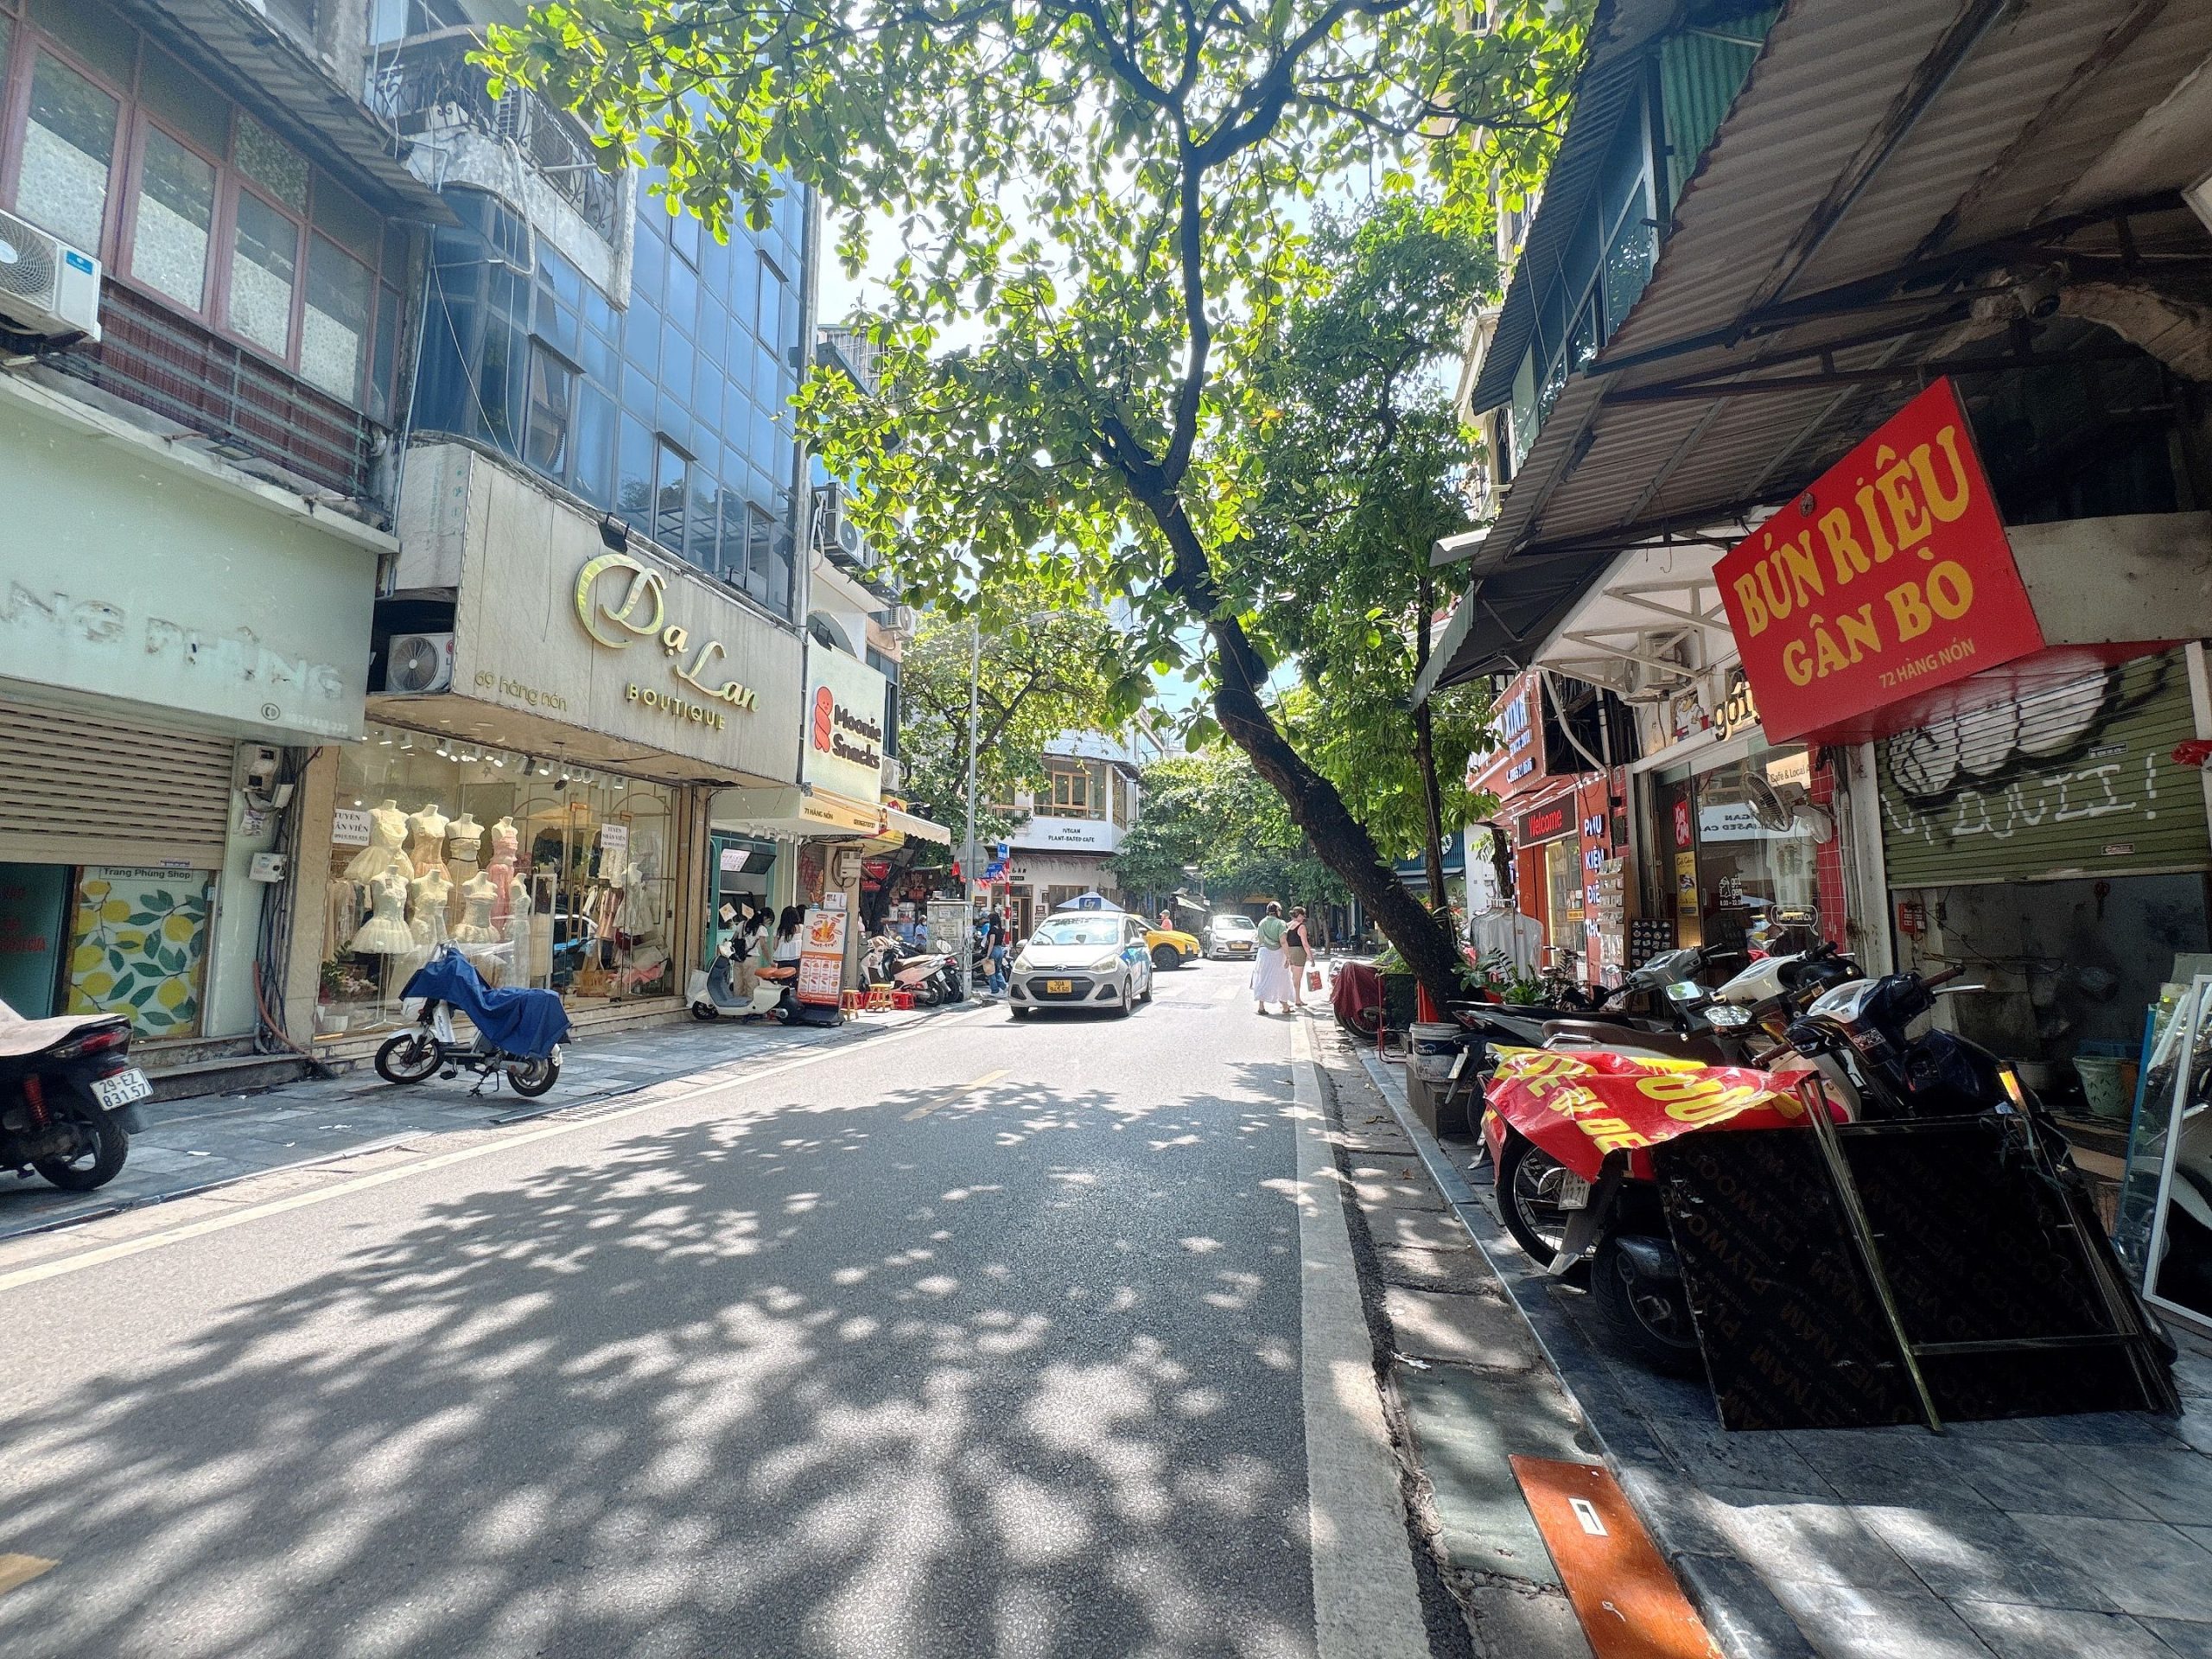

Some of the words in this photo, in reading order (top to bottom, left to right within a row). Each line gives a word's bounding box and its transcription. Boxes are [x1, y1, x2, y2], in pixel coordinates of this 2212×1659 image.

[1733, 530, 1825, 638] BÚN
[1783, 603, 1881, 686] GÂN
[1885, 546, 1974, 642] BÒ
[474, 670, 495, 689] 69
[674, 640, 760, 713] Lan
[1878, 671, 1897, 689] 72
[1897, 655, 1938, 683] HÀNG
[1940, 637, 1975, 667] NÓN
[626, 683, 726, 730] BOUTIQUE
[834, 704, 881, 743] Moonie
[832, 733, 880, 770] Snacks
[1529, 809, 1562, 837] Welcome
[103, 868, 132, 878] Trang
[167, 870, 191, 880] Shop
[103, 1084, 146, 1107] 831.57
